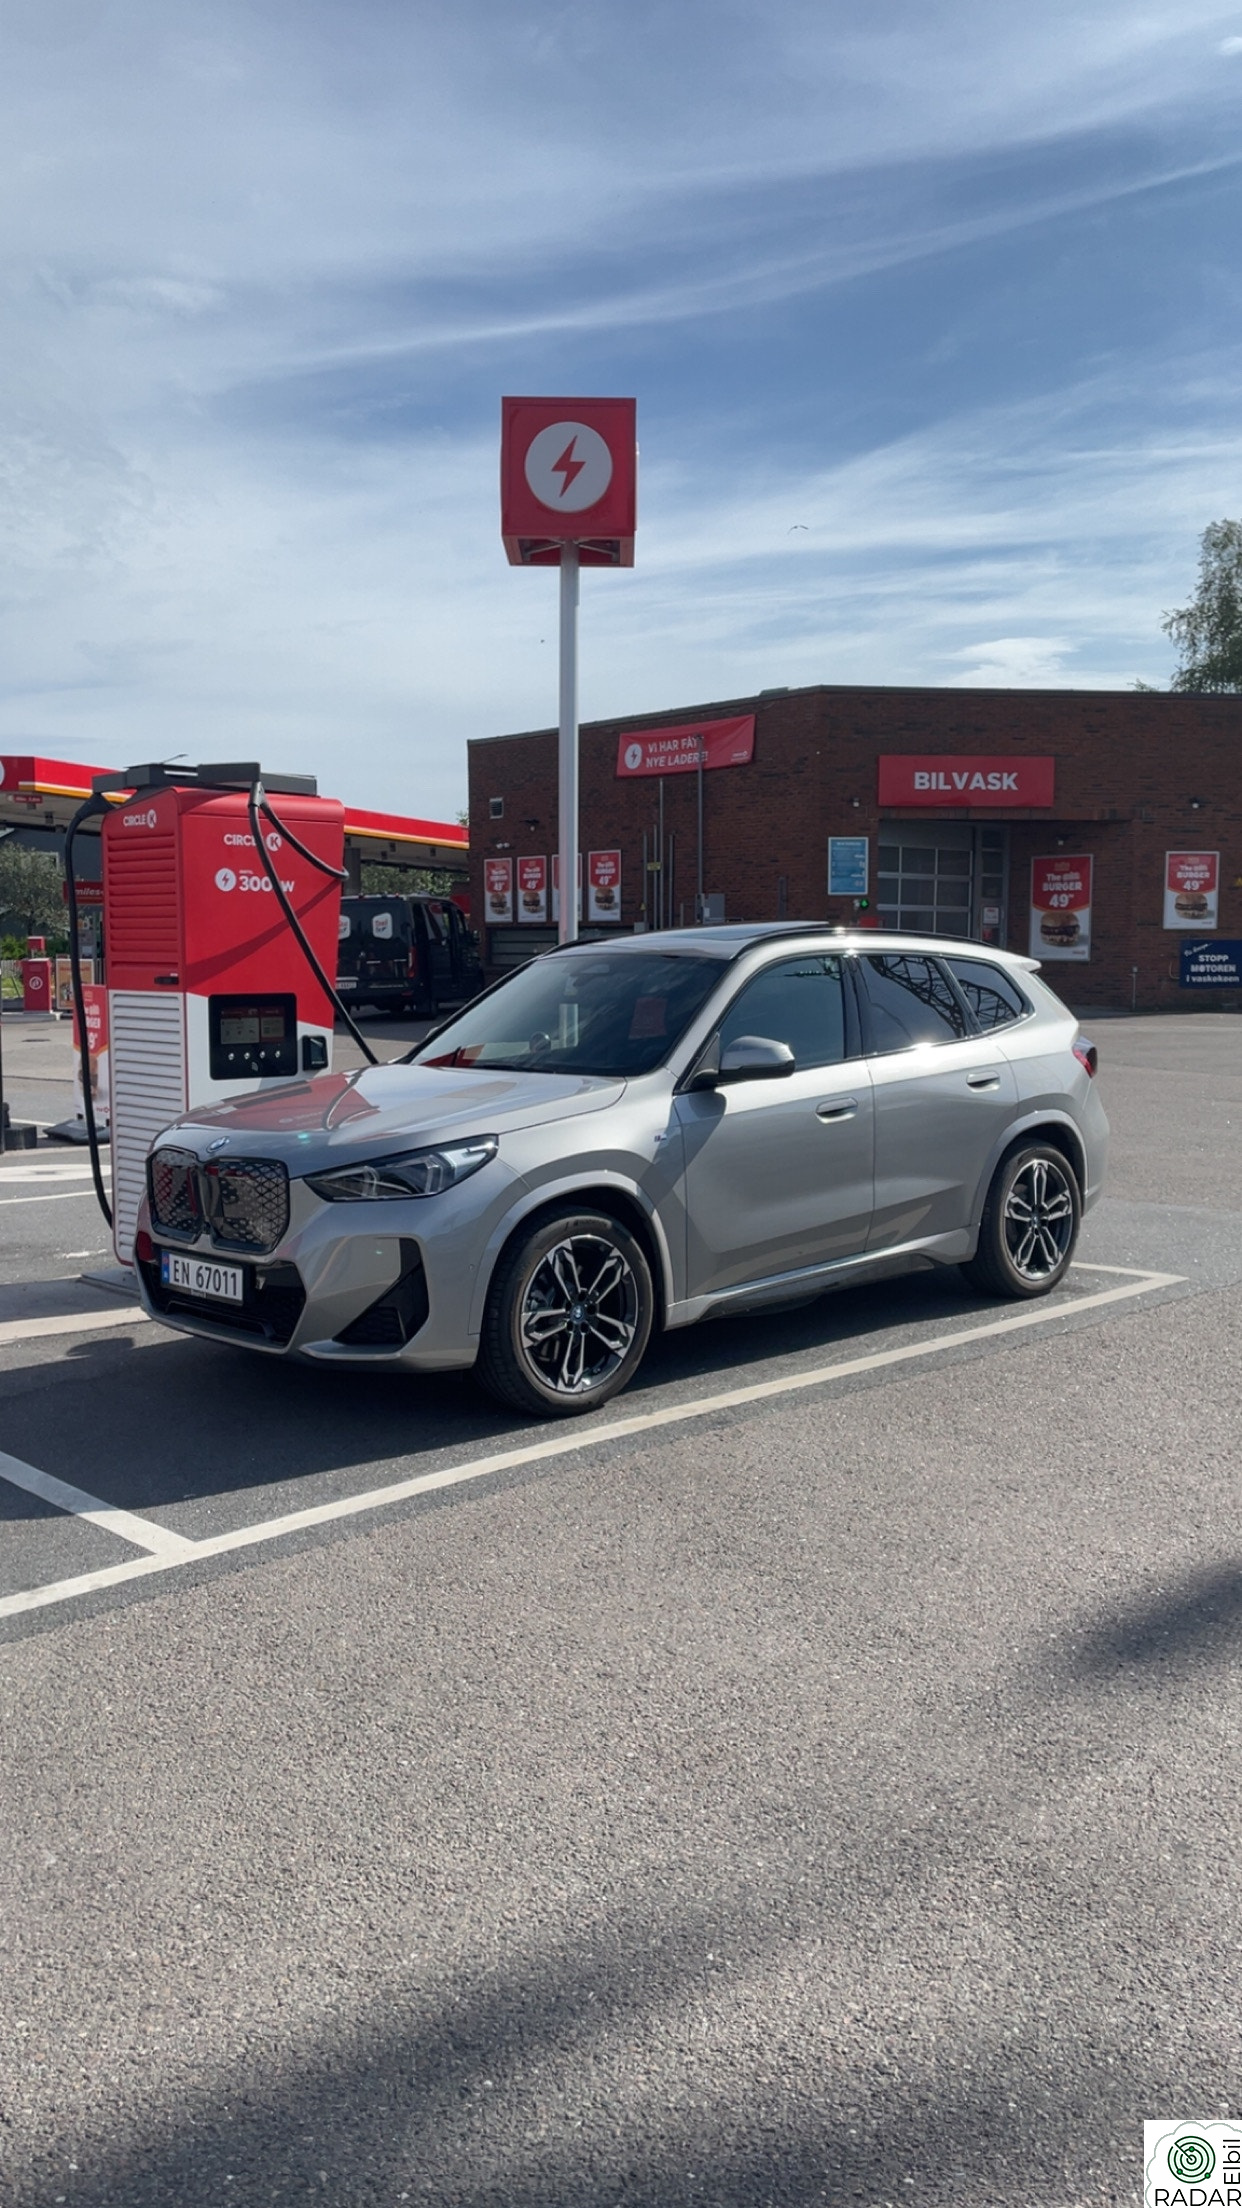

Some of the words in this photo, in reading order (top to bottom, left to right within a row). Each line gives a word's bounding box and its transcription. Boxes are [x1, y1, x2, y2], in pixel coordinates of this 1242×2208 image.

[648, 743, 658, 753] VI
[659, 741, 679, 752] HAR
[681, 735, 704, 750] FÅT
[645, 756, 666, 768] NYE
[914, 771, 1019, 790] BILVASK
[123, 814, 147, 827] CIRCLE
[147, 809, 157, 829] K
[223, 833, 258, 847] CIRCL
[266, 832, 282, 851] K
[1176, 871, 1210, 879] BURGER
[239, 876, 295, 892] 300W
[1042, 881, 1082, 891] BURGER
[1198, 954, 1229, 962] STOPP
[173, 1260, 190, 1286] EN
[196, 1265, 237, 1297] 67011
